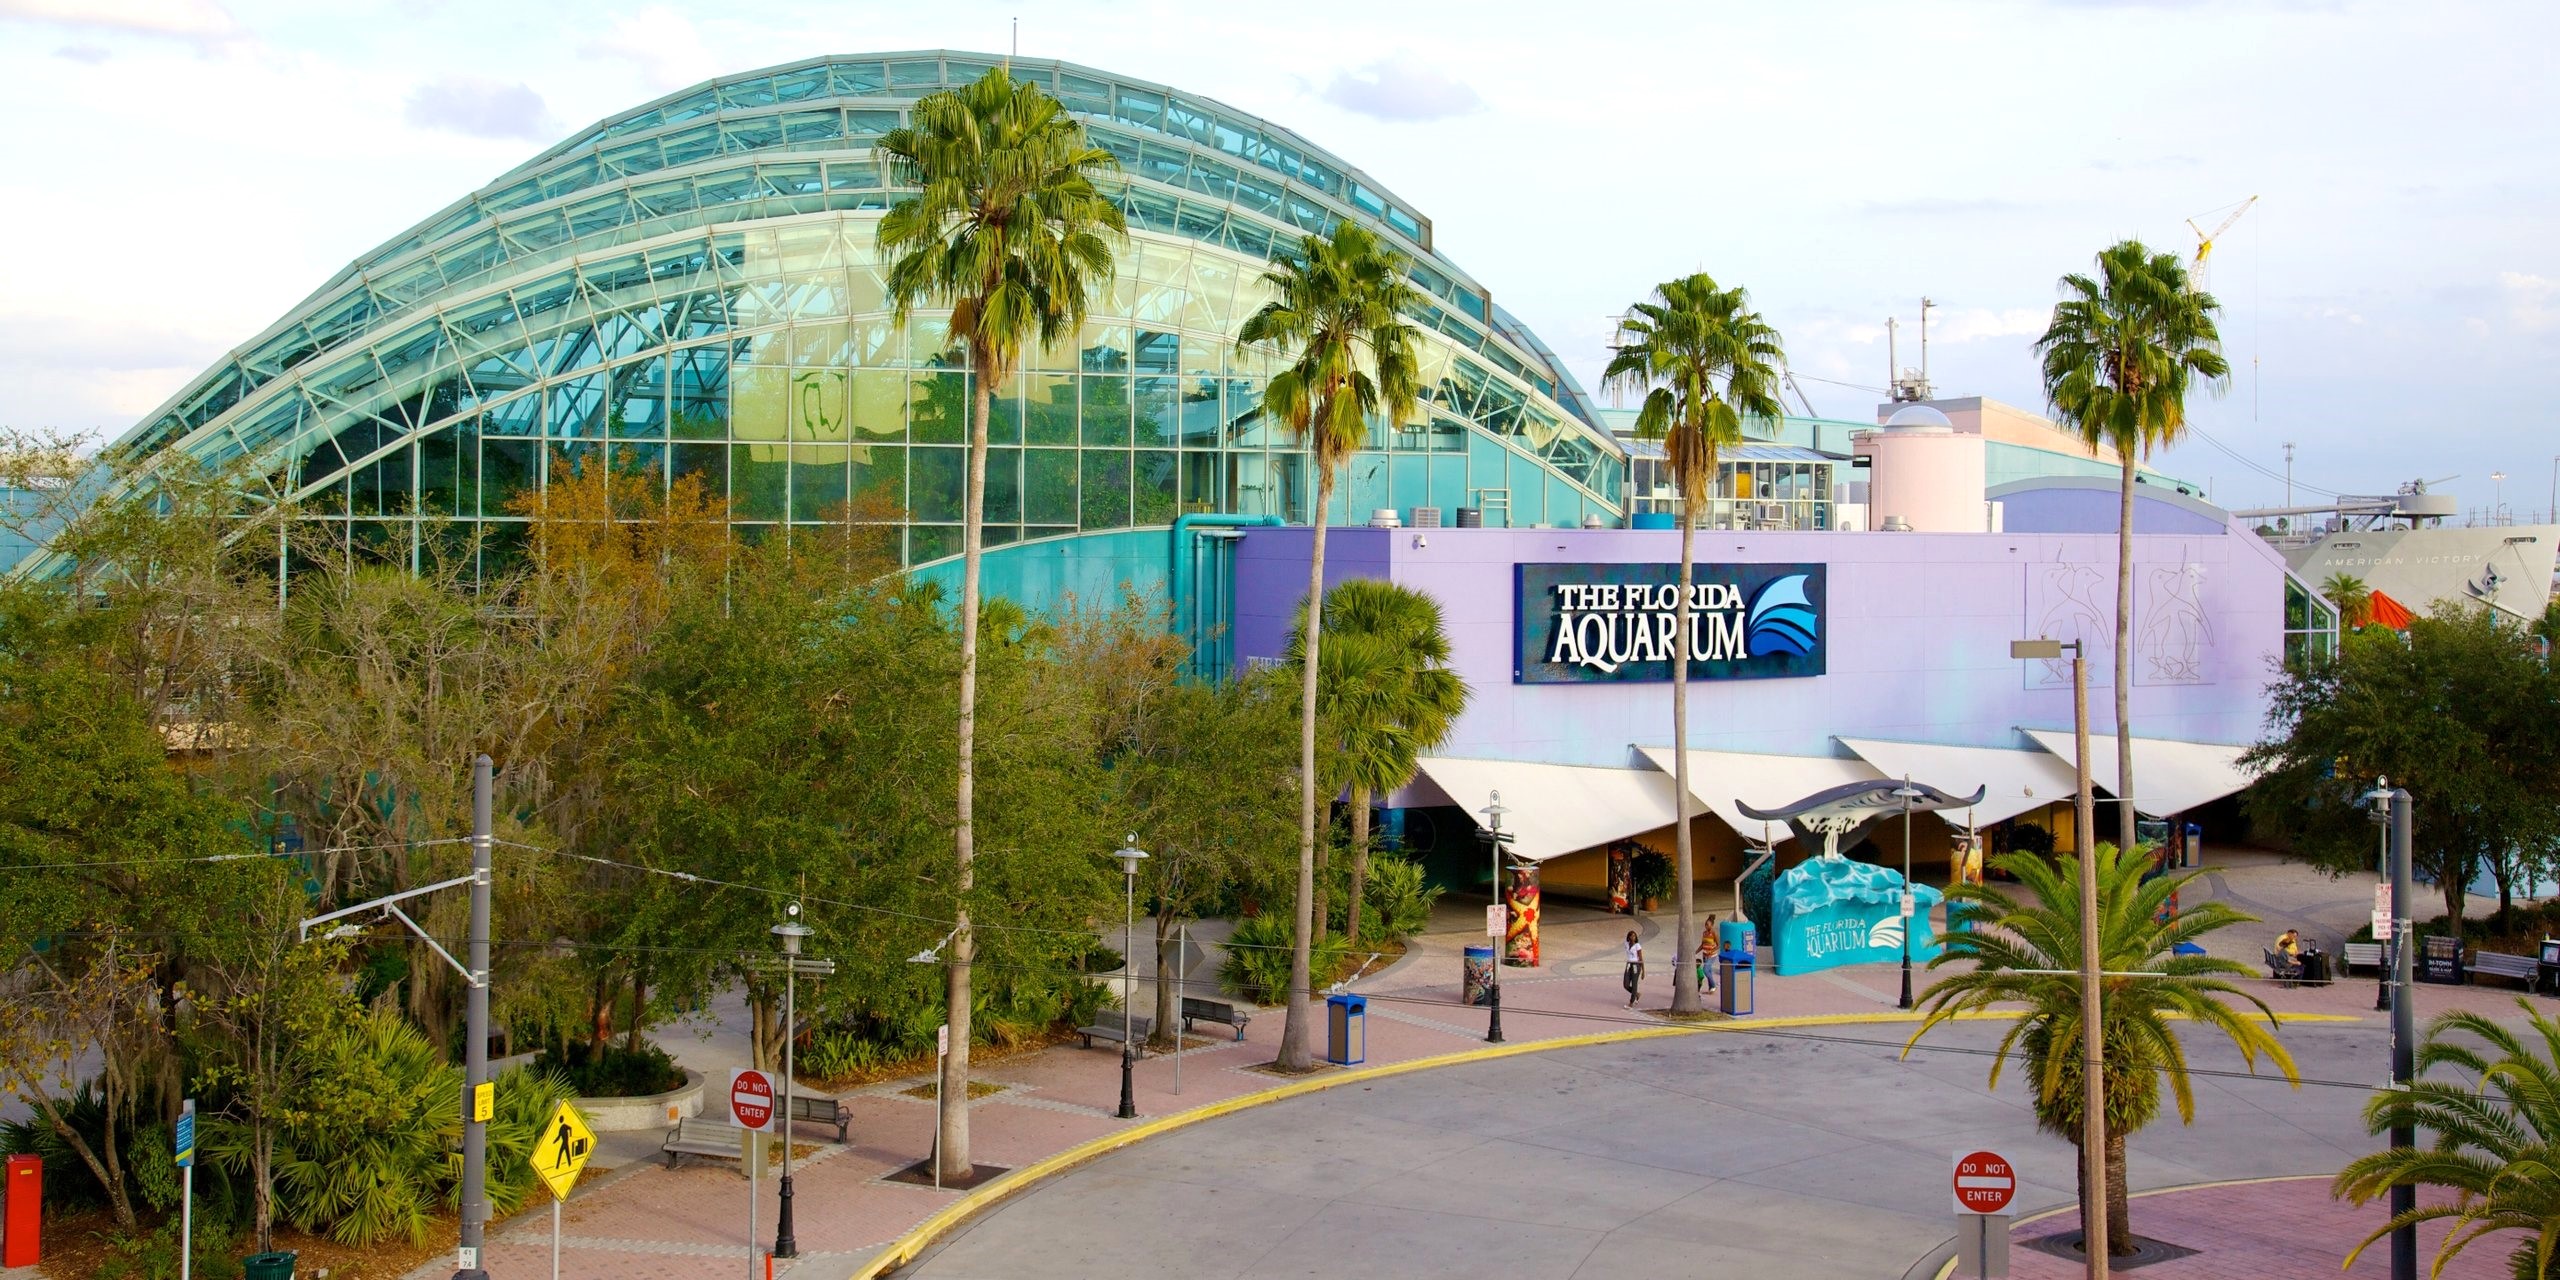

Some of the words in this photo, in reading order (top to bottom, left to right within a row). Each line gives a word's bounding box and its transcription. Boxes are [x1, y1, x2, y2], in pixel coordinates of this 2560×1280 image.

[2324, 557, 2404, 566] AMERICAN
[2416, 554, 2481, 564] VICTORY
[1558, 584, 1620, 611] THE
[1624, 584, 1746, 610] FLORIDA
[1805, 925, 1821, 938] THE
[1806, 930, 1866, 959] AQUARIUM
[737, 1080, 749, 1091] DO
[752, 1082, 768, 1094] NOT
[476, 1090, 493, 1099] SPEED
[481, 1106, 488, 1117] 5
[740, 1106, 765, 1119] ENTER
[1962, 1163, 1977, 1174] DO
[1985, 1163, 2006, 1174] NOT
[1967, 1190, 2002, 1202] ENTER
